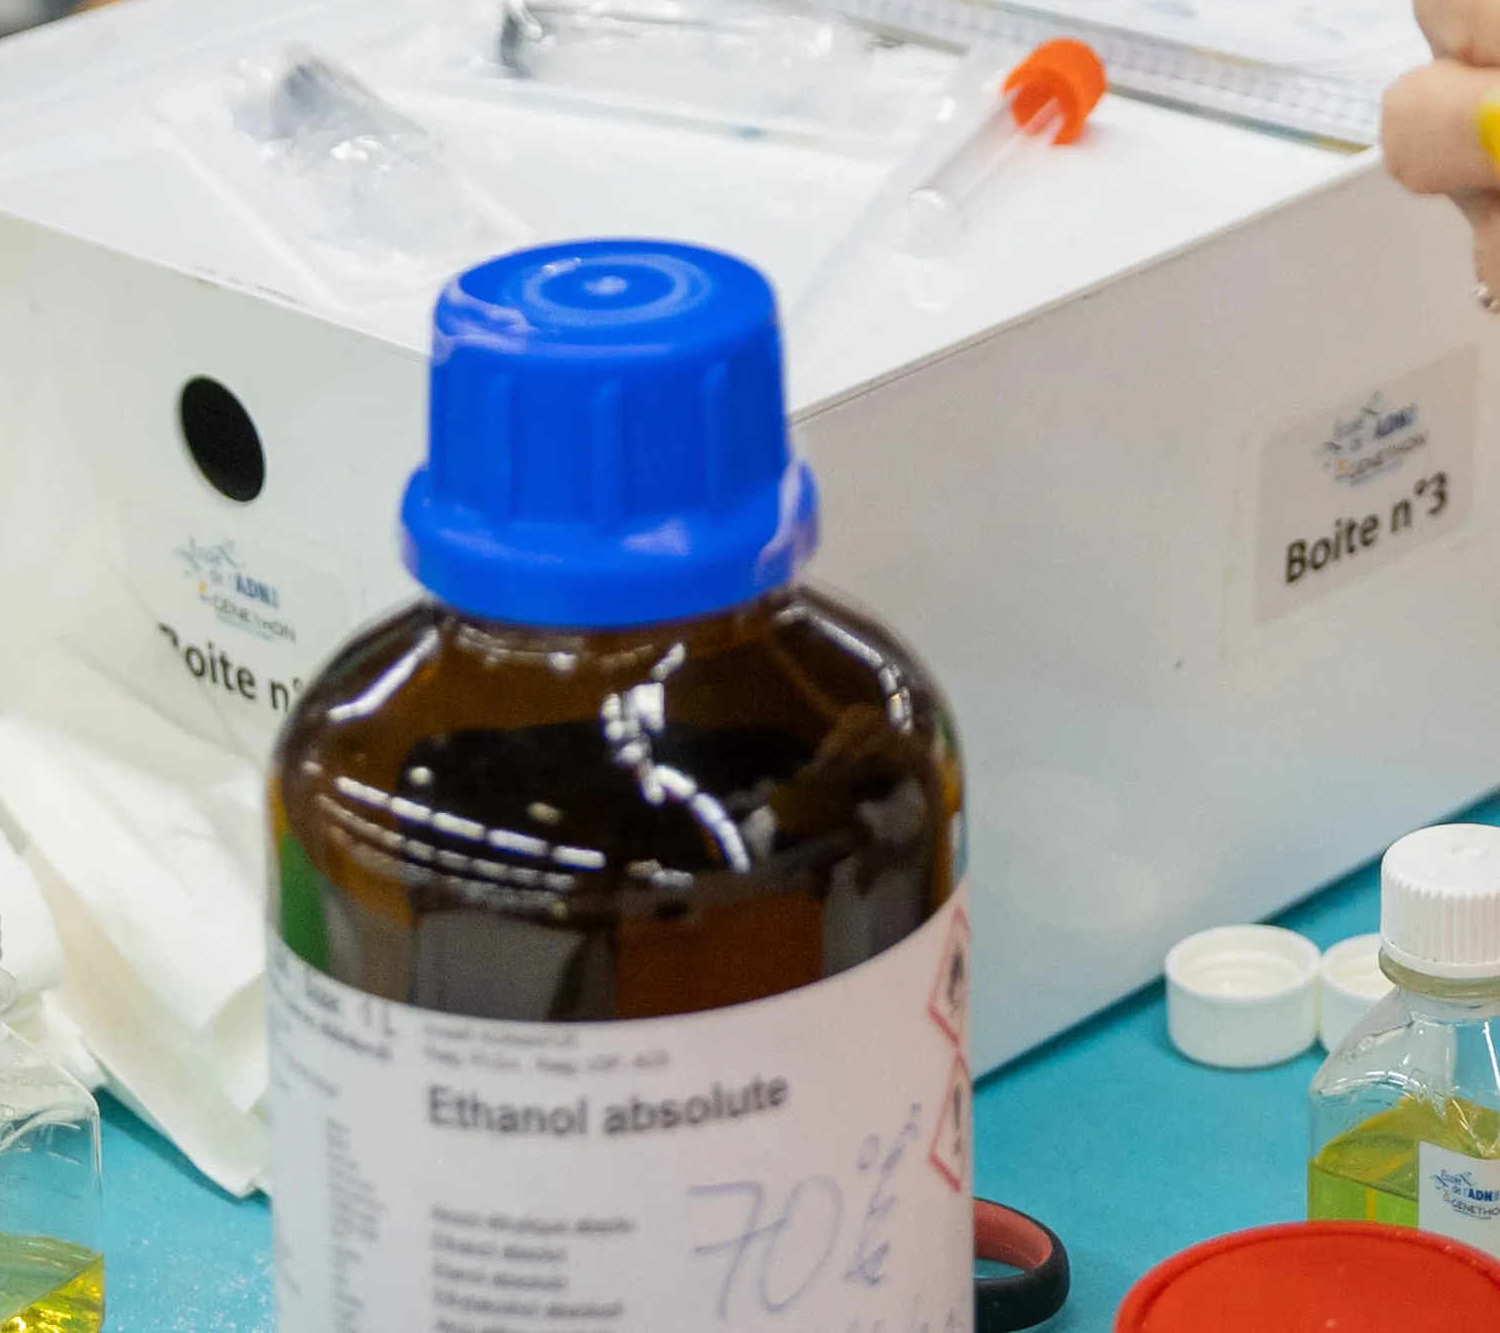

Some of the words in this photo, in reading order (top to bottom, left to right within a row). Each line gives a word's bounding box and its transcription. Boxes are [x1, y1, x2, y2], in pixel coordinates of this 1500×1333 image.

[1286, 515, 1380, 584] Boite
[1390, 470, 1448, 534] n°3
[428, 1082, 589, 1135] Ethanol
[603, 1075, 790, 1135] absolute
